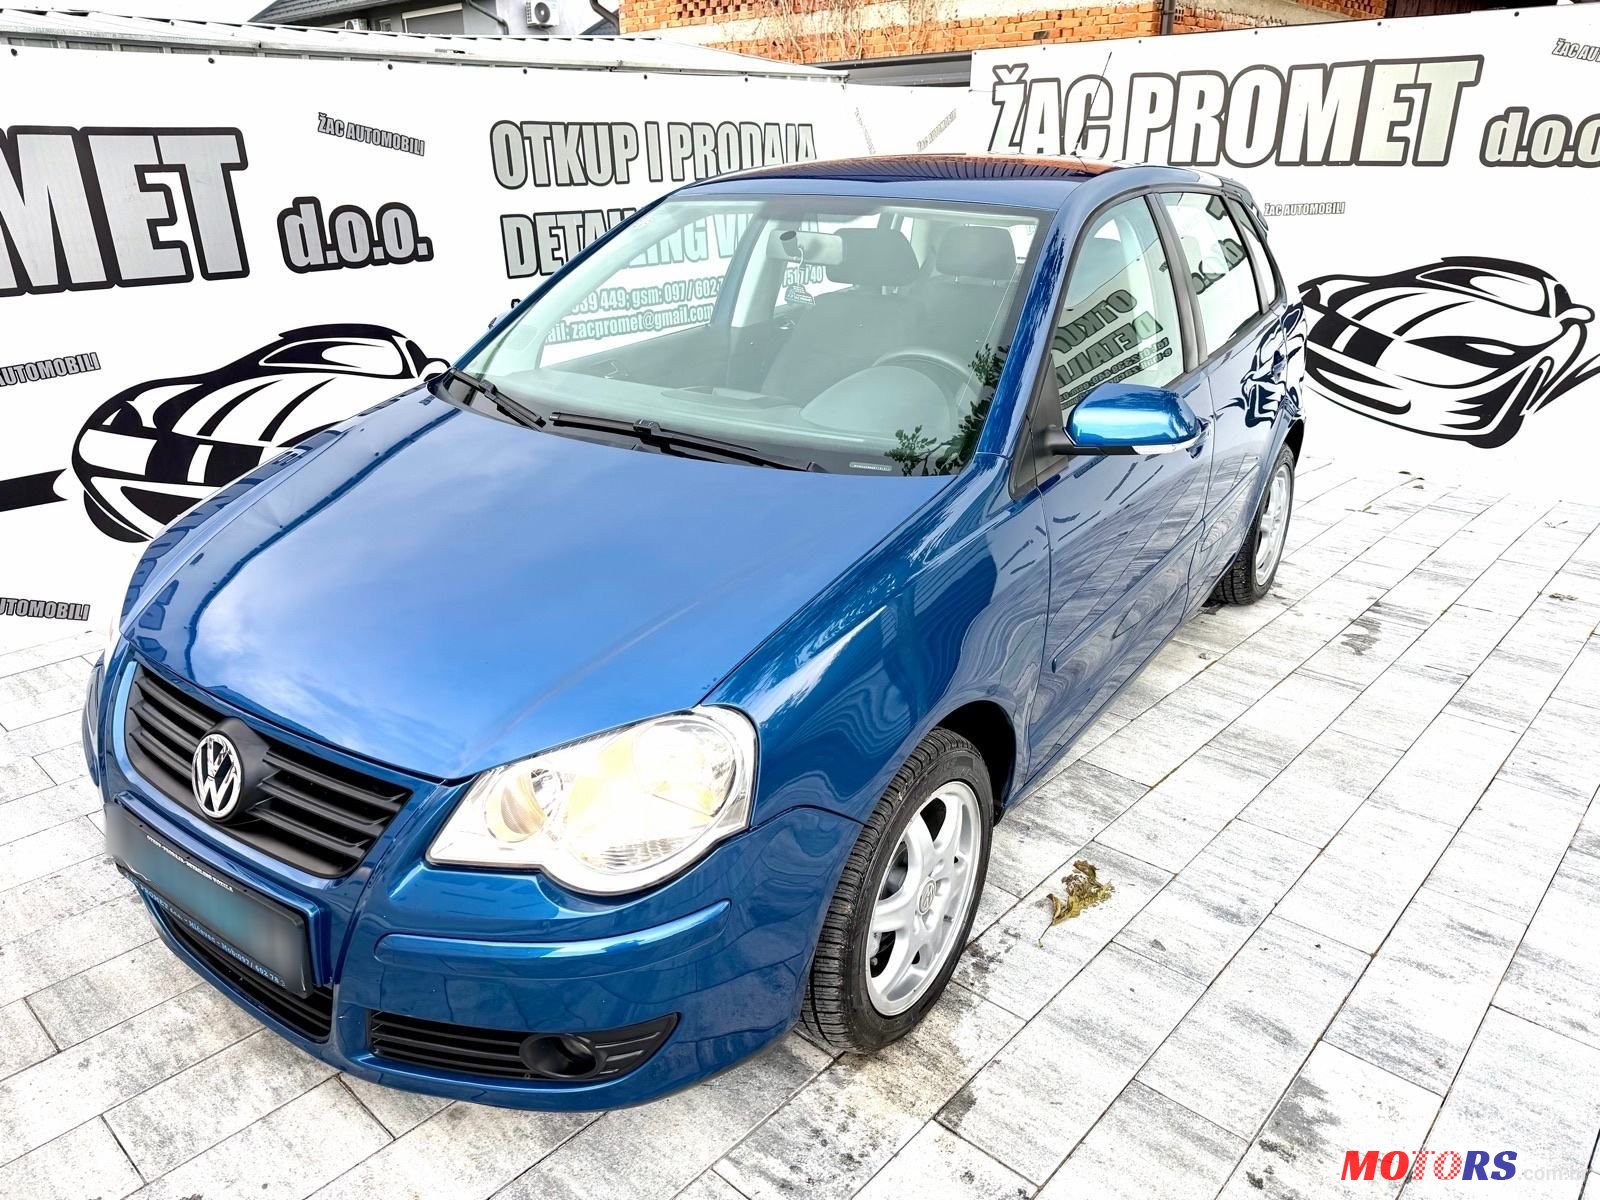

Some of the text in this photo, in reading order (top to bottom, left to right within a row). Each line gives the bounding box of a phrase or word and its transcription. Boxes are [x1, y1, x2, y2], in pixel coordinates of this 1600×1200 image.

[1552, 37, 1581, 58] ŽAC
[318, 111, 426, 157] ŽAC AUTOMOBILI
[988, 62, 1114, 160] ŽAC
[1120, 54, 1485, 168] PROMET
[490, 120, 640, 189] OTKUP
[644, 121, 664, 182] I
[277, 196, 435, 273] d.o.o.
[1264, 201, 1346, 217] ŽAC AUTOMOBILI
